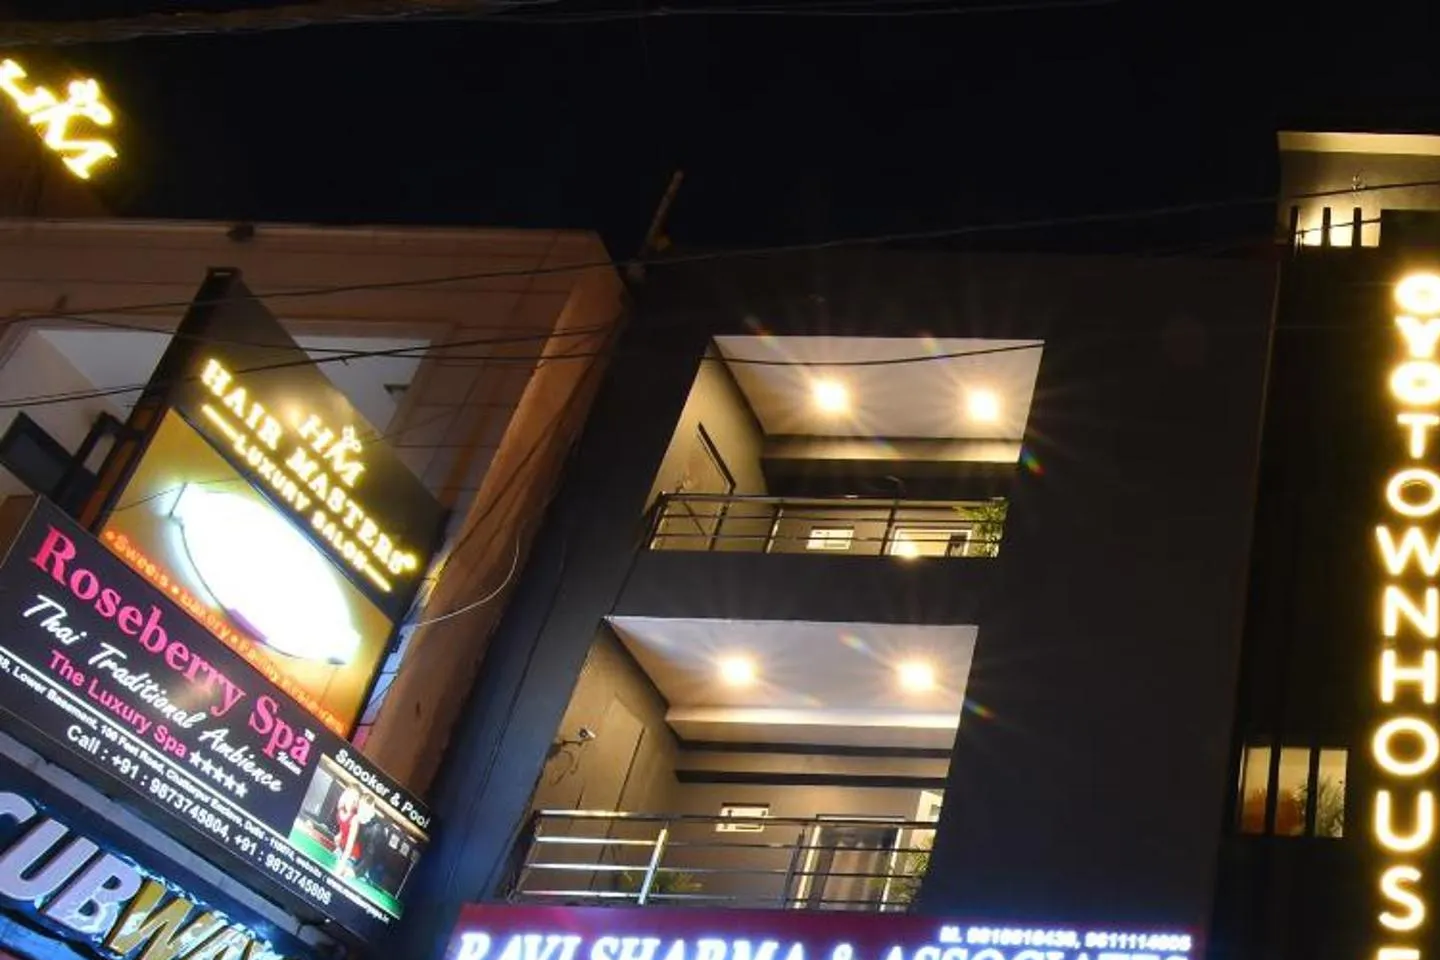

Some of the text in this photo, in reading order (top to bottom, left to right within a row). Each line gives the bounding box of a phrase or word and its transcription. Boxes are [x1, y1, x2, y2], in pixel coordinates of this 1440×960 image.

[201, 358, 405, 574] HAIR MASTERS
[233, 434, 368, 571] LUXURY SALON
[13, 665, 47, 695] Lower
[23, 594, 284, 792] Thai Traditional Ambience
[30, 523, 311, 766] Roseberry Spa
[49, 650, 188, 759] The Luxury Spa
[66, 724, 101, 755] Call
[335, 748, 431, 829] Snooker & Pool
